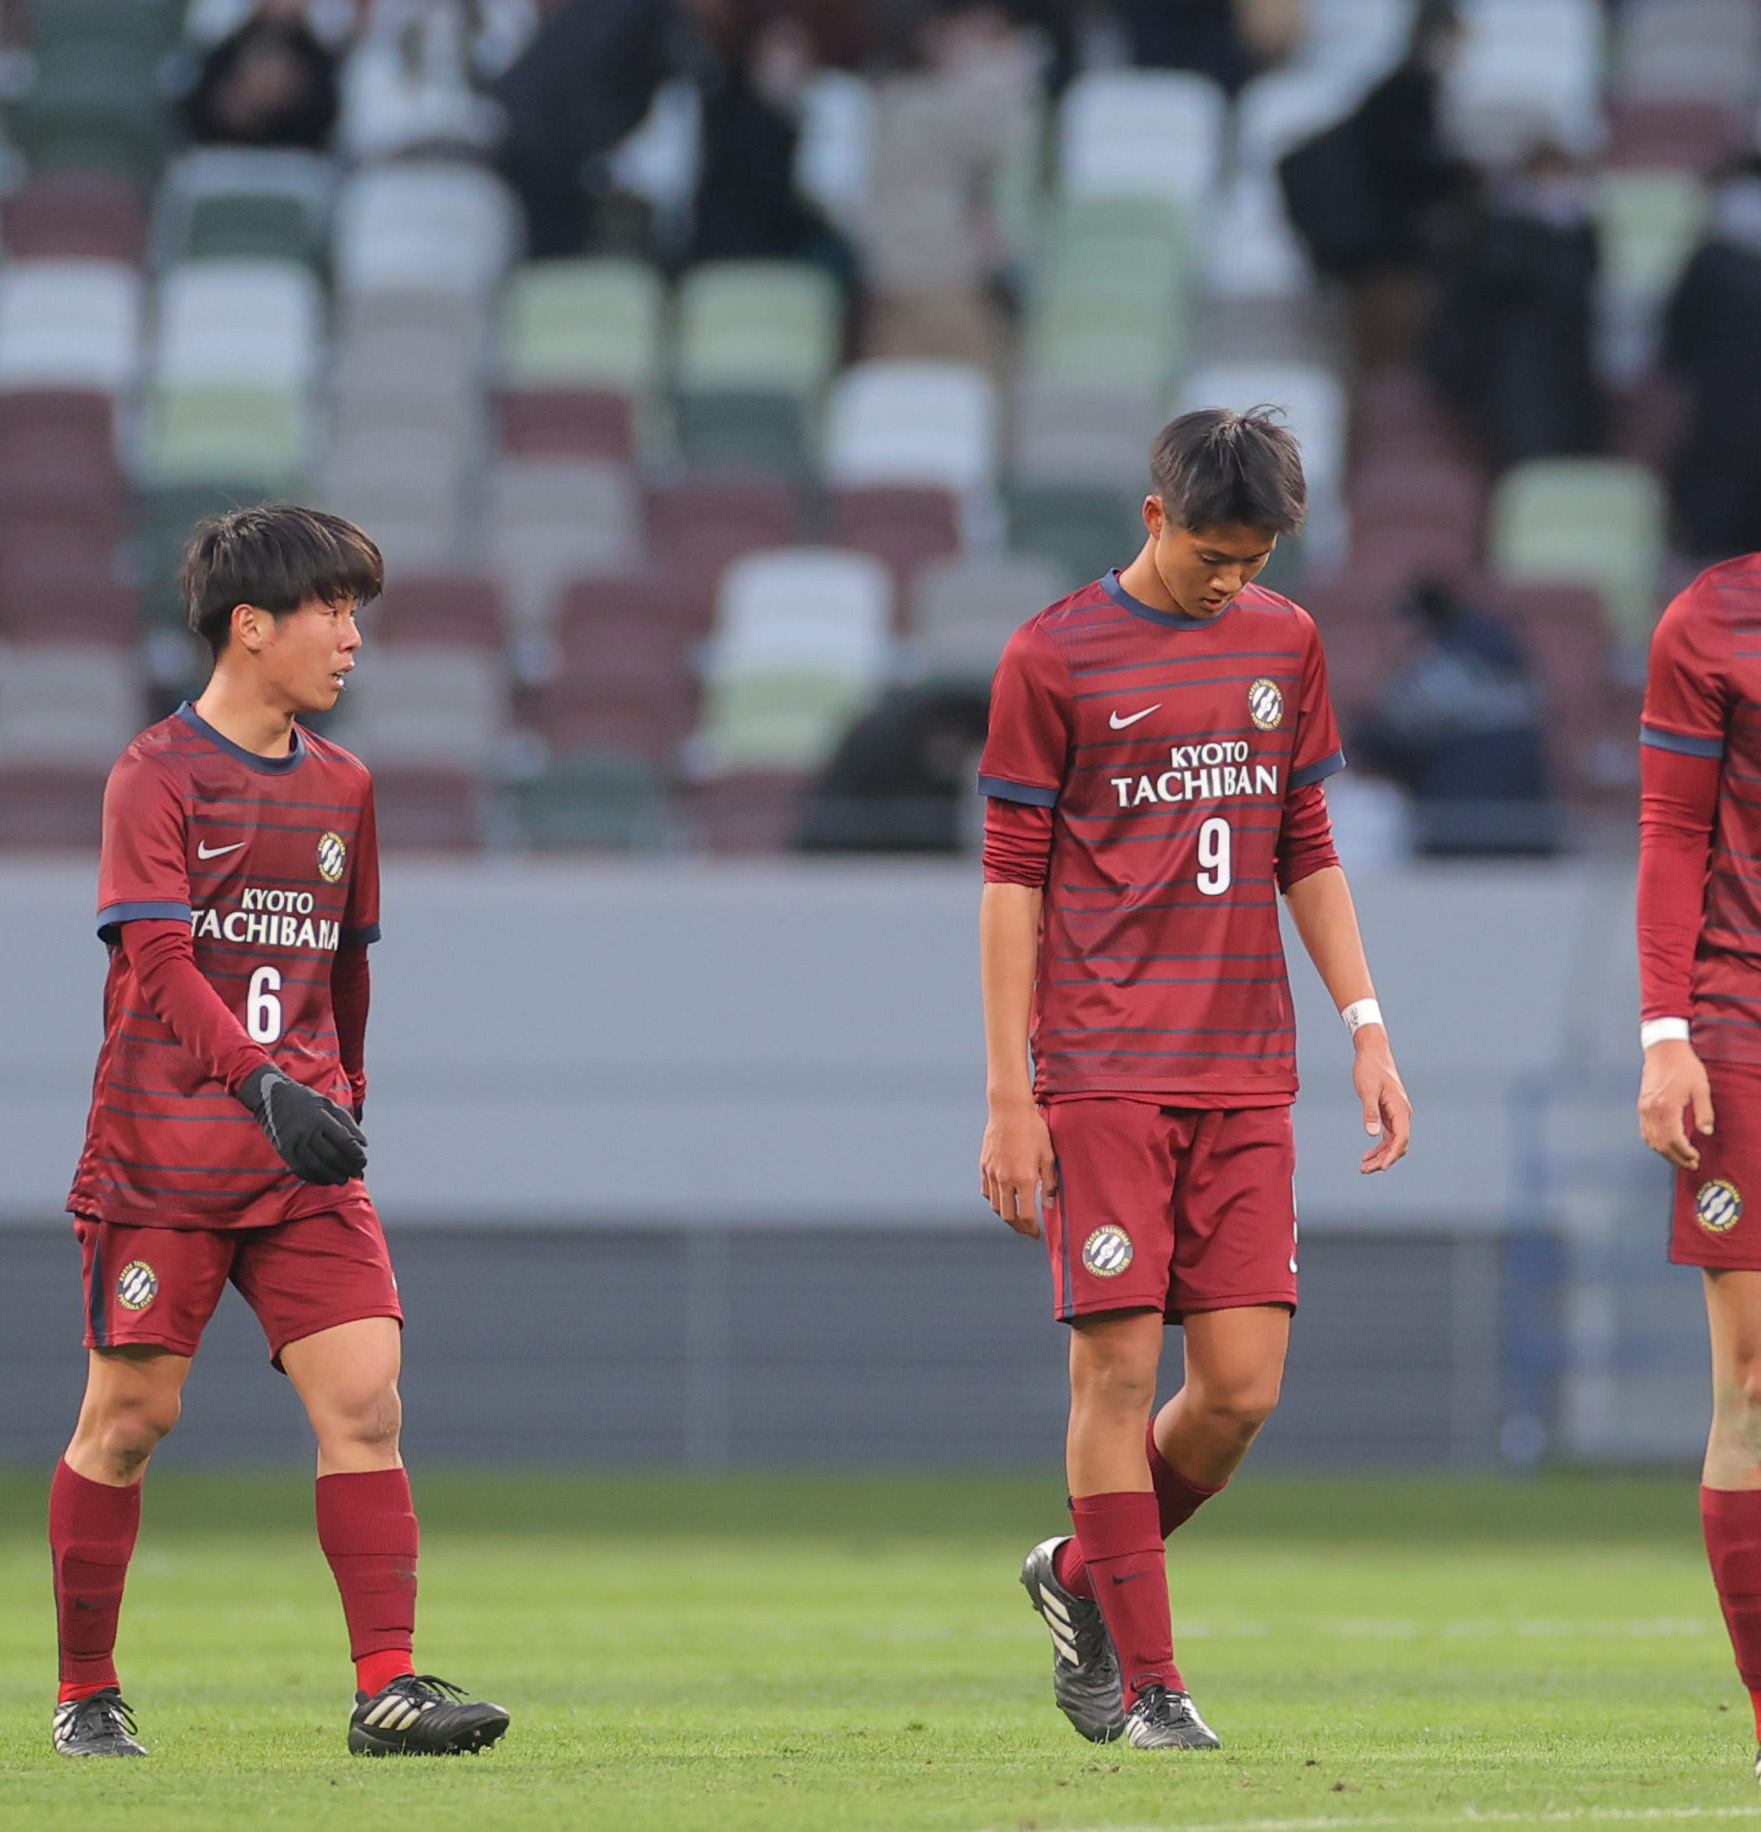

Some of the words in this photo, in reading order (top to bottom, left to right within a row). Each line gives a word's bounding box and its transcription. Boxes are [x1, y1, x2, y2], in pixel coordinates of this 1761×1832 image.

[1170, 740, 1249, 768] KYOTO
[1110, 764, 1278, 808] TACHIBAN
[1196, 817, 1232, 896] 9
[240, 887, 314, 915] KYOTO
[247, 966, 283, 1044] 6
